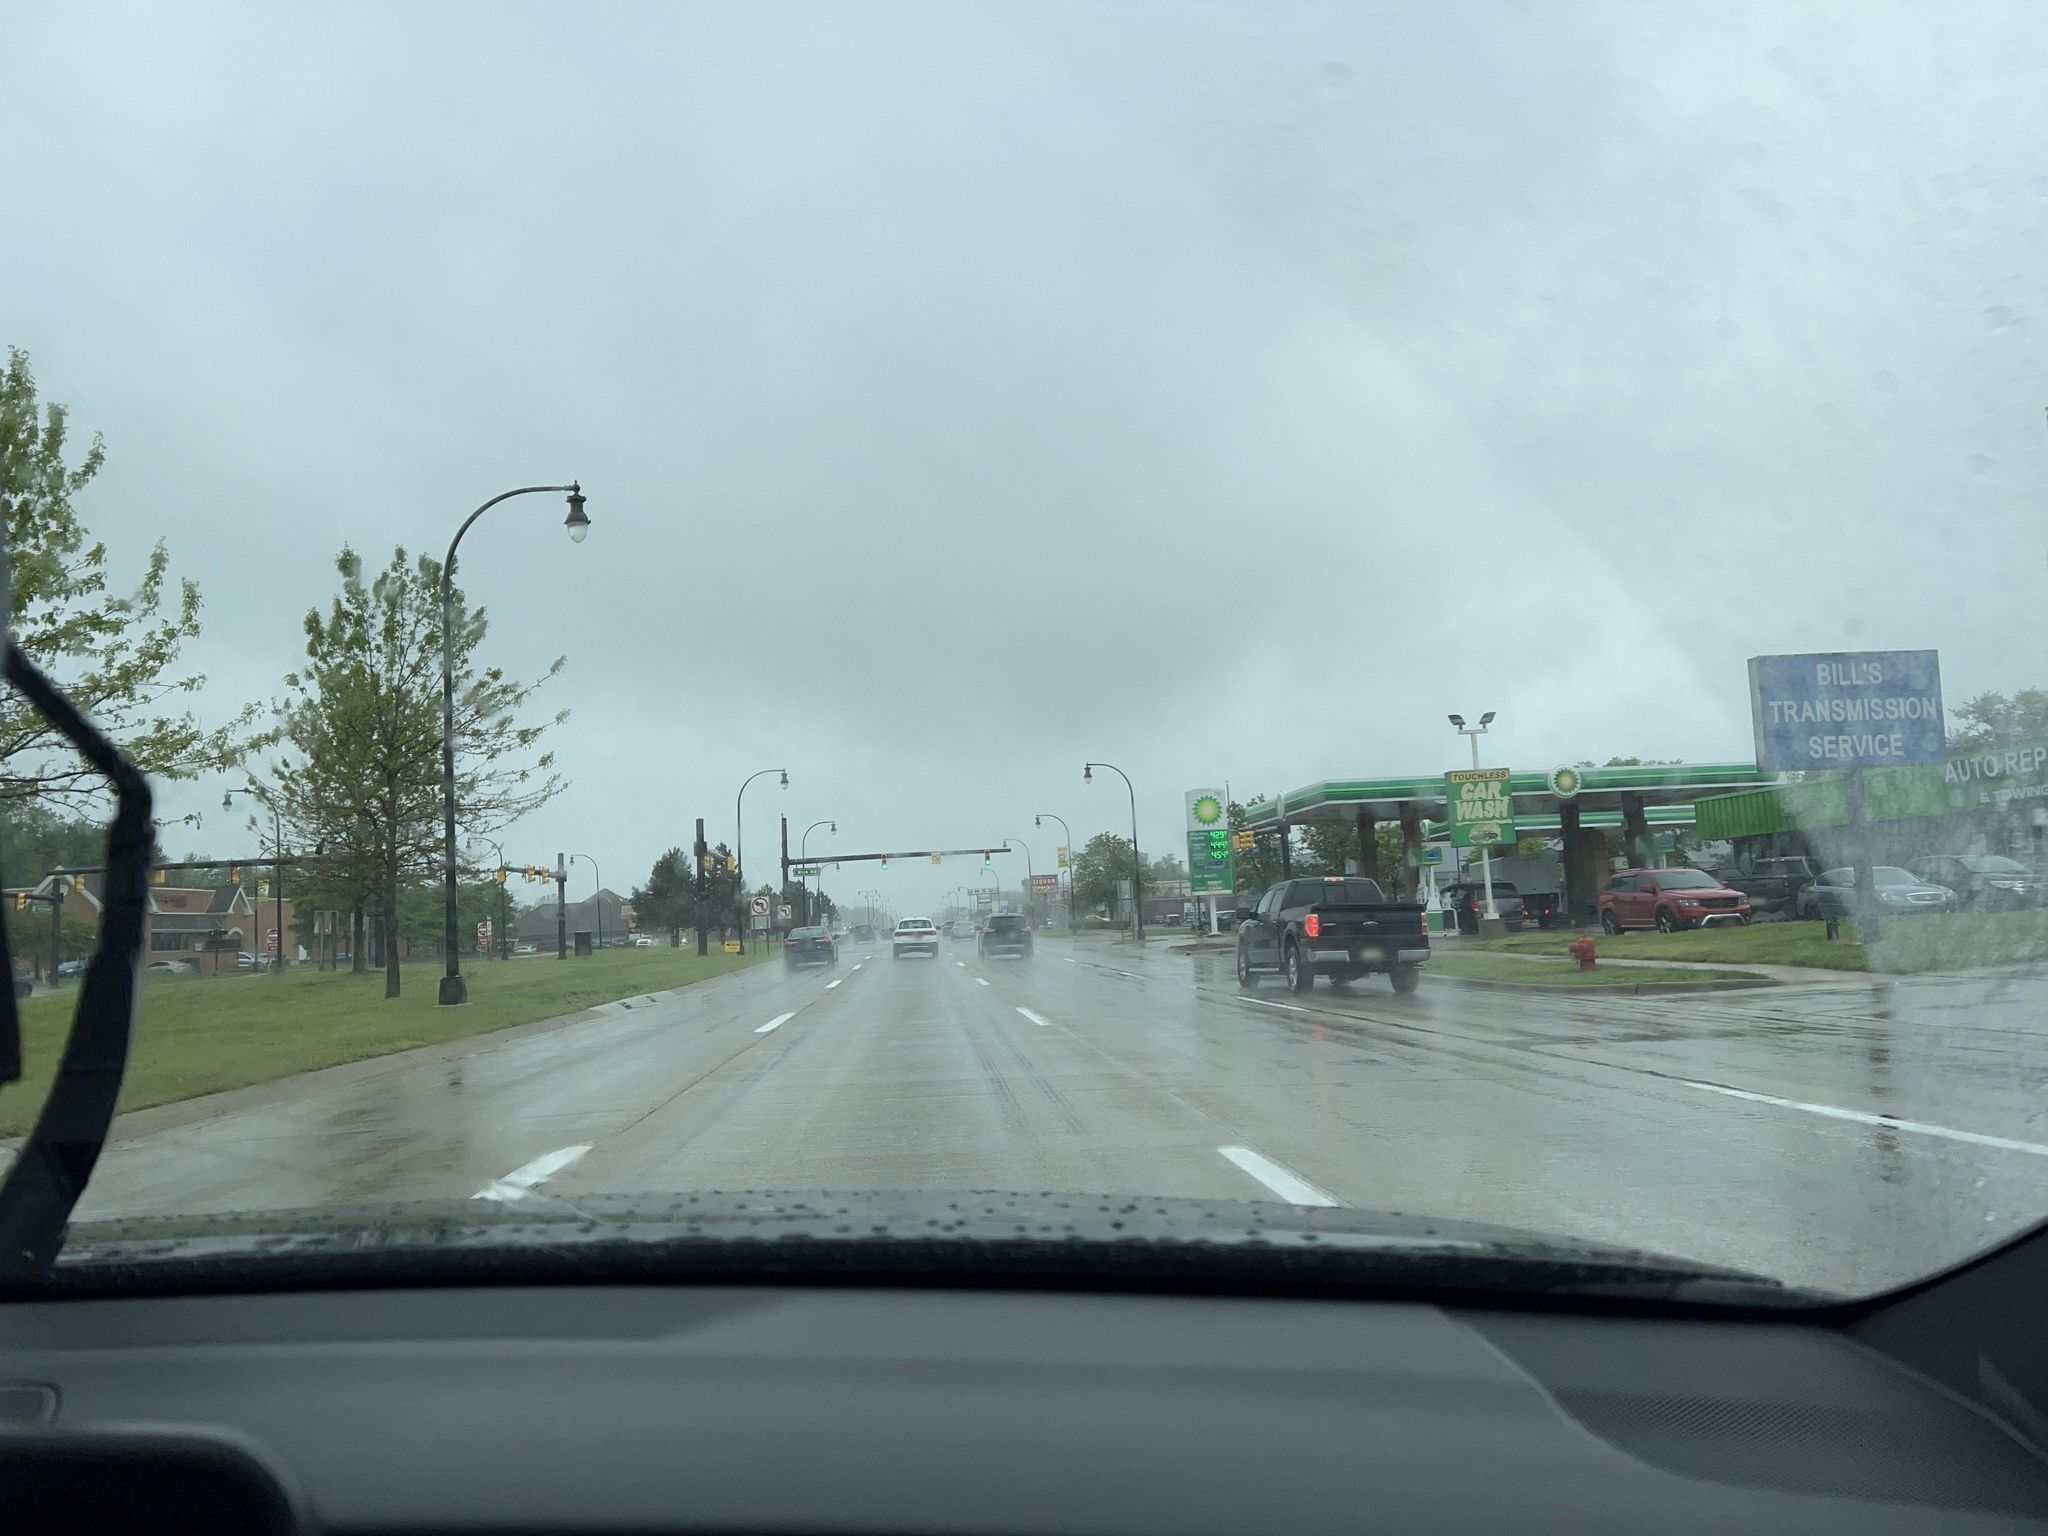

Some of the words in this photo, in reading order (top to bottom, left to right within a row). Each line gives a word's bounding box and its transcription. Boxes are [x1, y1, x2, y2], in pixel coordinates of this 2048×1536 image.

[1816, 662, 1883, 686] BILL'S
[1768, 696, 1937, 723] TRANSMISSION
[1809, 734, 1905, 759] SERVICE
[1454, 772, 1506, 781] TOUCHLESS
[1945, 755, 1999, 783] AUTO
[1462, 781, 1503, 799] CAR
[1992, 784, 2048, 801] TOWING
[1455, 799, 1509, 820] WASH
